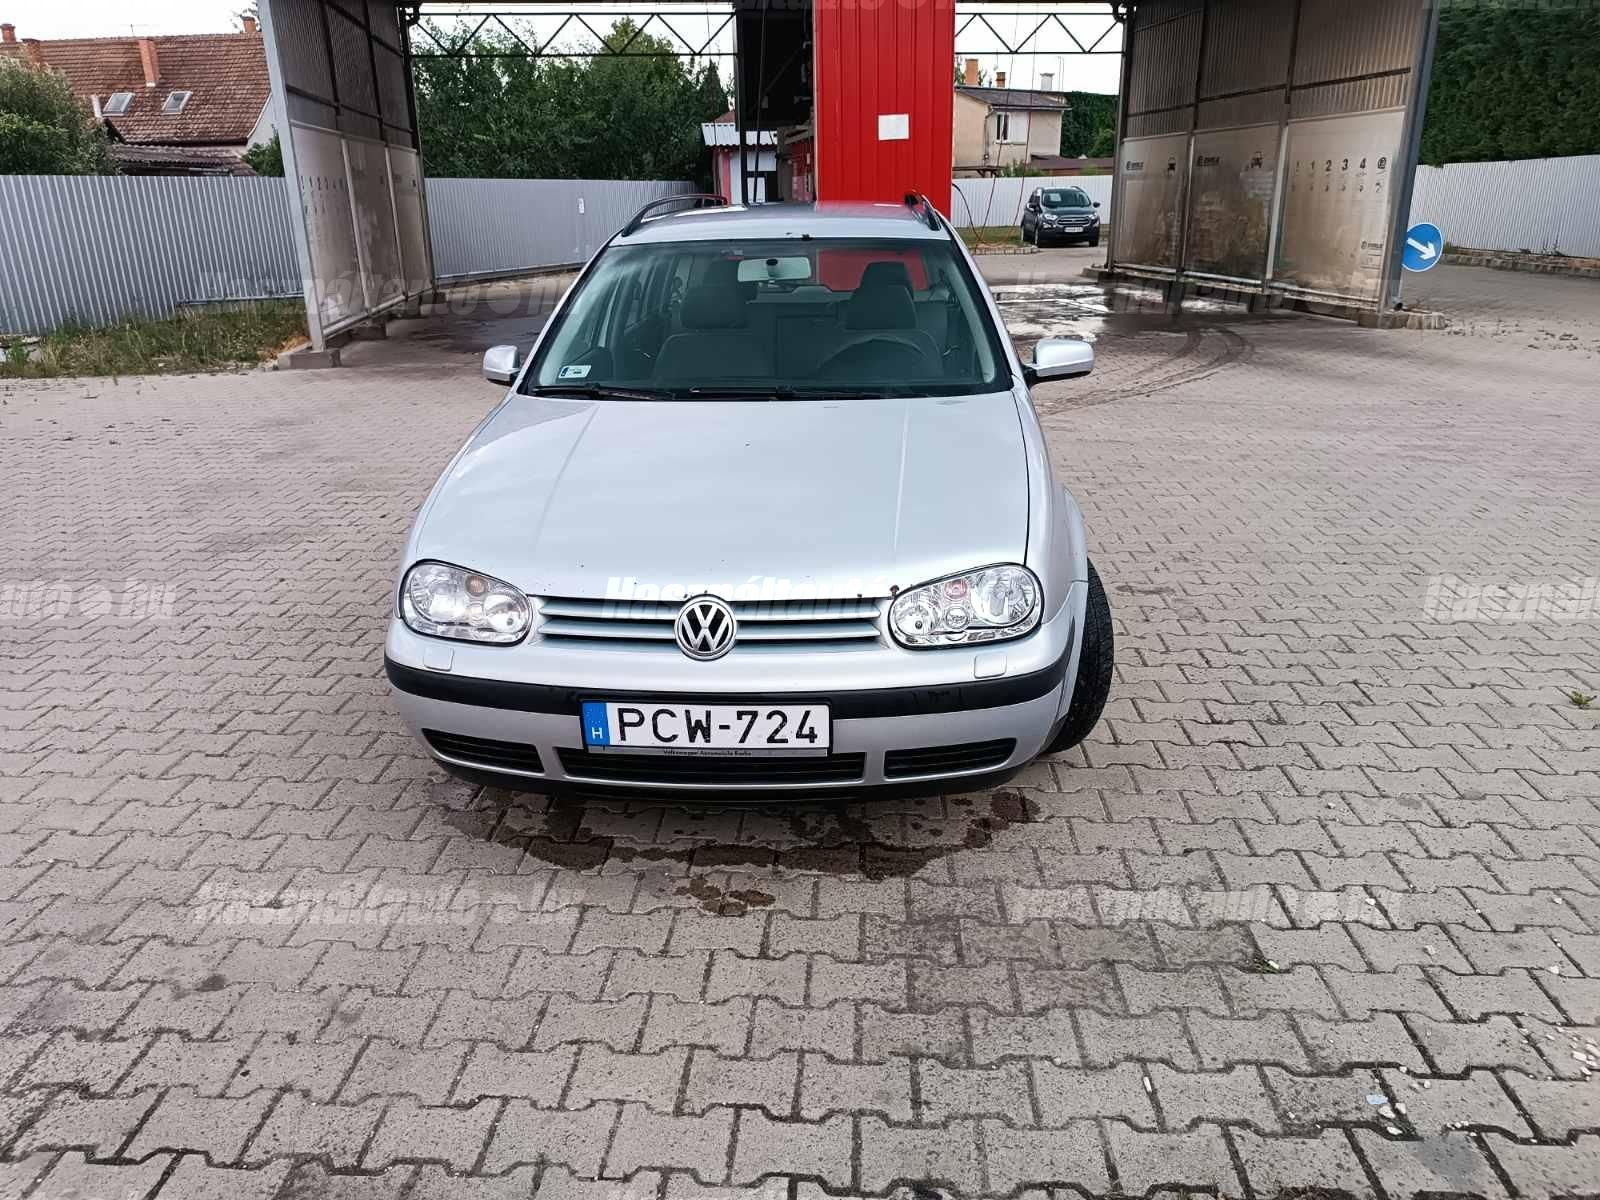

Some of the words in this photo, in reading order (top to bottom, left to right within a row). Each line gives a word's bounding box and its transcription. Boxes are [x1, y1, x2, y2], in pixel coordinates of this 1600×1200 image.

[1325, 159, 1332, 172] 2
[1342, 158, 1349, 171] 3
[1359, 157, 1366, 169] 4
[679, 600, 733, 655] VW
[592, 726, 603, 739] H
[617, 707, 818, 744] PCW-724
